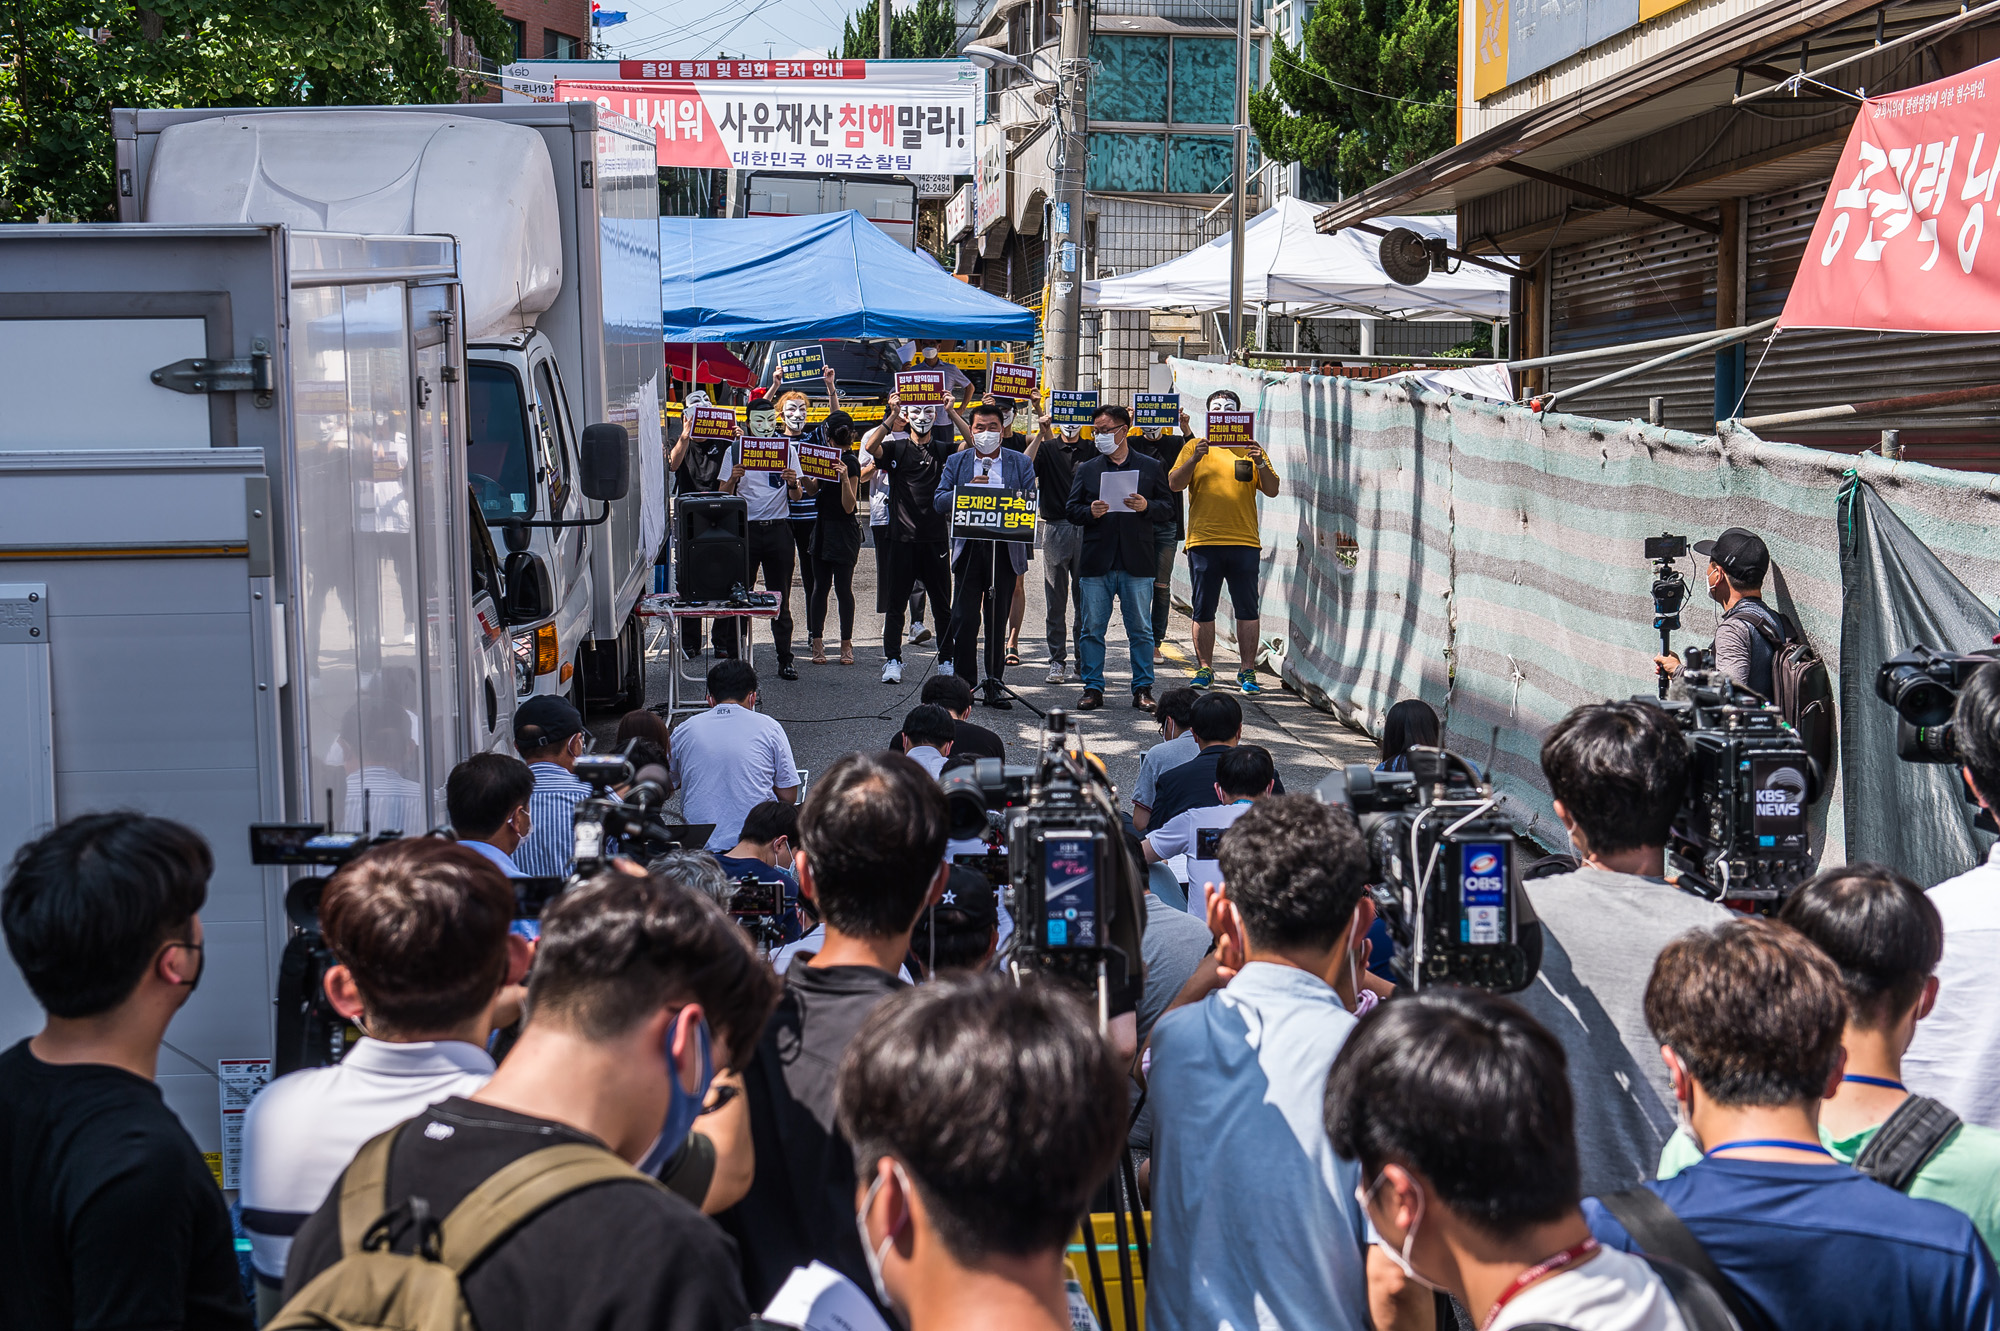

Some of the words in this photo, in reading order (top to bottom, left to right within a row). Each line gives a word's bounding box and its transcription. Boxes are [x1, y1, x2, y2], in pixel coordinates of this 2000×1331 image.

[642, 63, 672, 78] 출입
[679, 63, 710, 78] 통제
[716, 63, 731, 78] 및
[738, 62, 768, 78] 집회
[775, 62, 805, 77] 금지
[813, 62, 843, 77] 안내
[1939, 86, 1955, 109] 의한
[1956, 78, 1986, 104] 현수막임.
[719, 102, 833, 146] 사유재산
[838, 102, 965, 150] 침해말라!
[733, 151, 807, 168] 대한민국
[816, 152, 912, 171] 애국순찰팀
[1820, 135, 1959, 271] 공권력
[1957, 132, 2000, 274] 낭
[996, 366, 1009, 375] 정부
[899, 375, 912, 384] 정부
[994, 375, 1014, 384] 교회에
[1014, 377, 1027, 386] 책임
[899, 384, 920, 392] 교회에
[920, 383, 934, 392] 책임
[697, 410, 710, 418] 정부
[1209, 415, 1223, 424] 정부
[695, 419, 715, 427] 교회에
[715, 420, 729, 429] 책임
[1209, 424, 1230, 433] 교회에
[1230, 424, 1244, 433] 책임
[744, 440, 757, 448] 정부
[743, 449, 764, 458] 교회에
[764, 450, 778, 459] 책임
[801, 446, 812, 455] 정부
[956, 495, 997, 510] 문재인
[999, 497, 1037, 511] 구속이
[954, 510, 1002, 528] 최고의
[1004, 512, 1036, 529] 방역
[1755, 789, 1786, 803] KBS
[1755, 803, 1800, 817] NEWS
[1465, 876, 1502, 891] OBS
